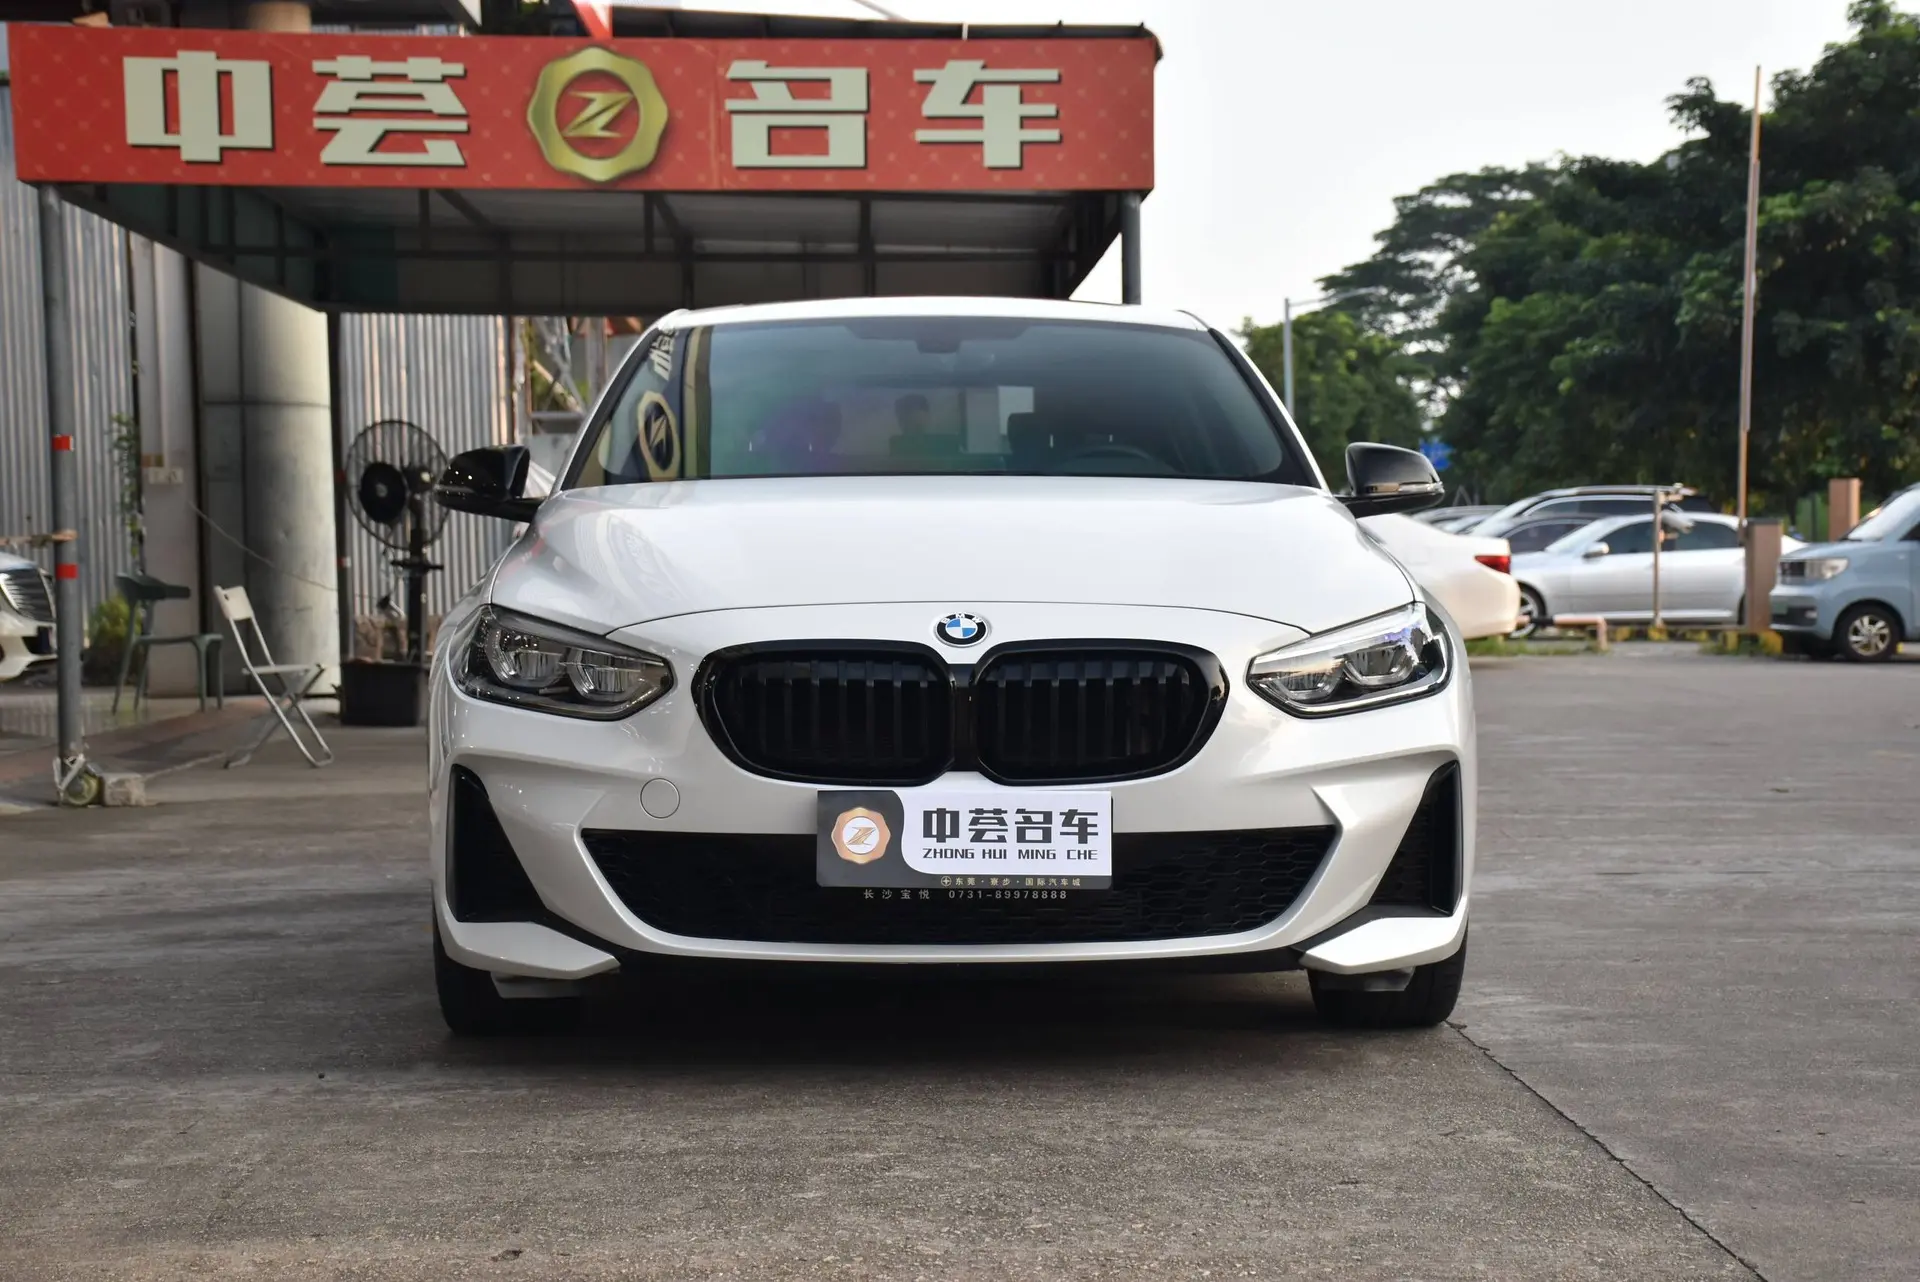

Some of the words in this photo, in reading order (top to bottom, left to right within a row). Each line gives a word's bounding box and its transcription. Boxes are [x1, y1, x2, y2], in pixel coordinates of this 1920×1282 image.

[725, 60, 1061, 168] 名车
[940, 611, 984, 625] BMW
[922, 807, 1099, 845] 中荟名车
[922, 847, 975, 860] ZHONG
[982, 848, 1007, 860] HUI
[1018, 848, 1056, 860] MING
[1066, 849, 1099, 861] CHE
[948, 889, 1068, 900] 0731-89978888
